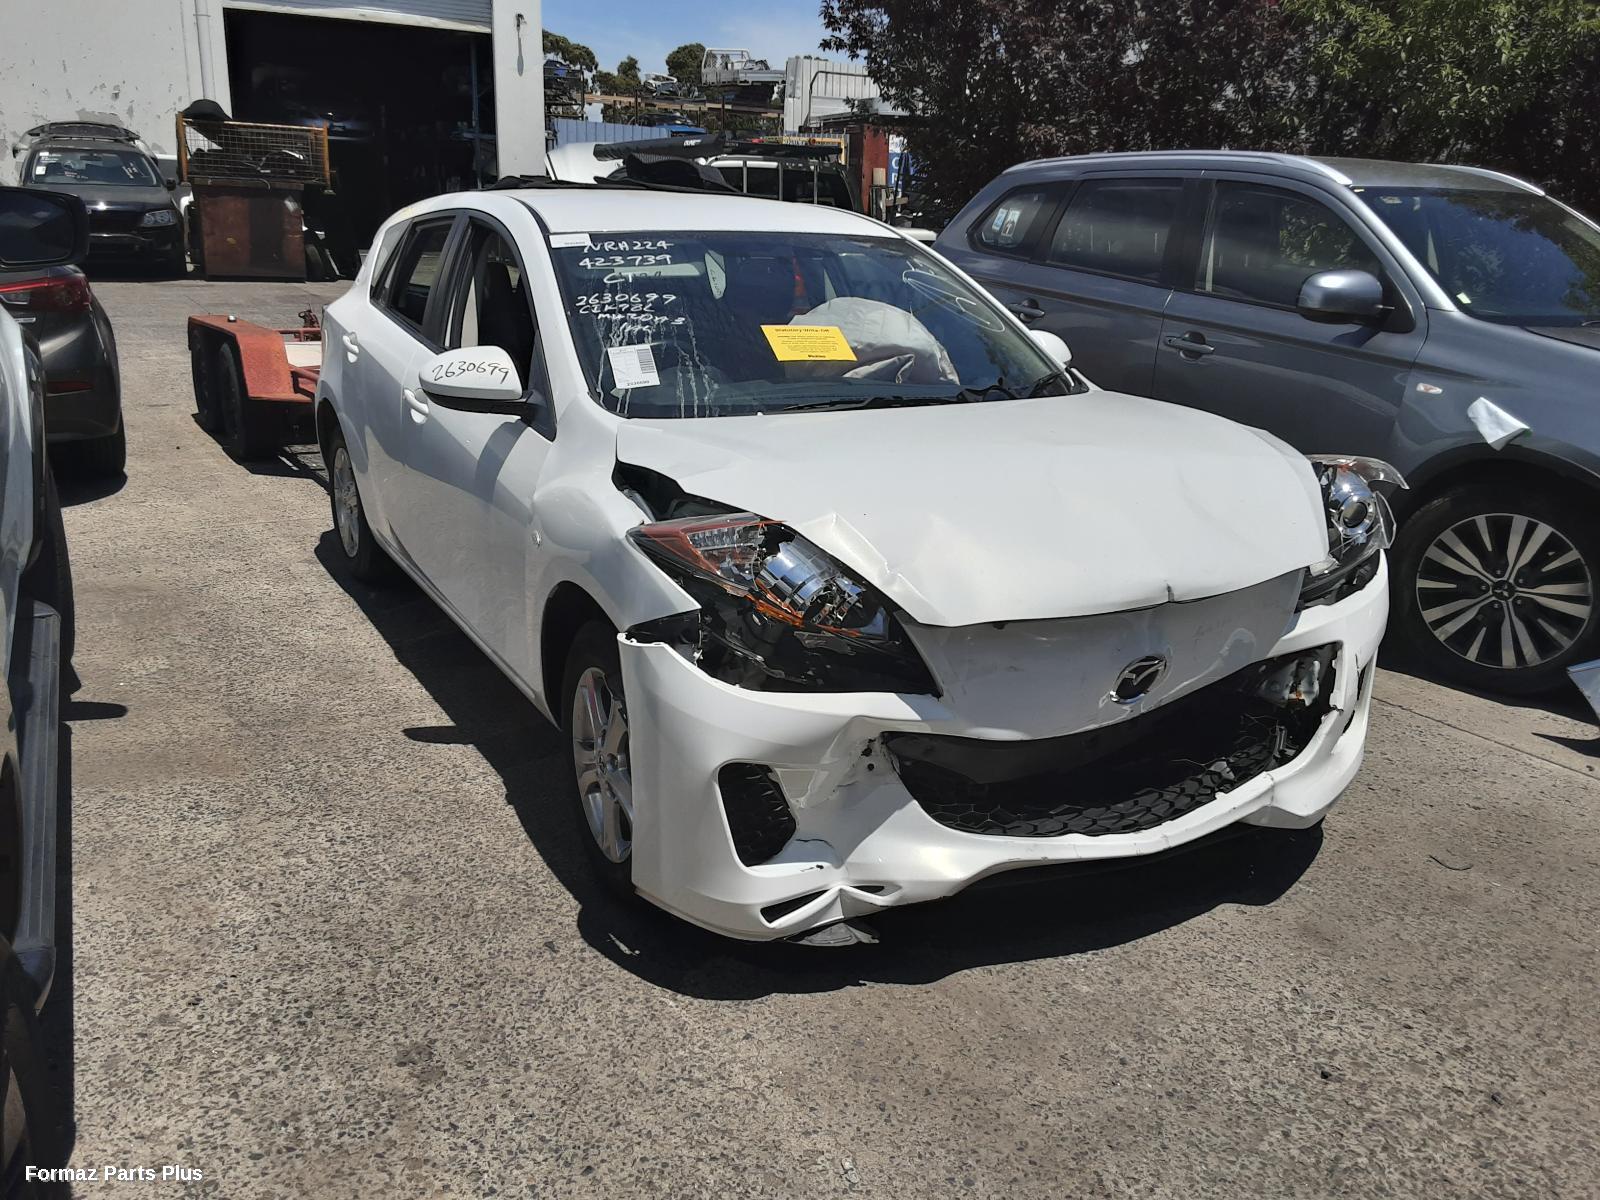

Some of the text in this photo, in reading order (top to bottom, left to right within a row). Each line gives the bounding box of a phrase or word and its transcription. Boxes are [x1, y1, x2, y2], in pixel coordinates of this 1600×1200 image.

[579, 254, 672, 269] 423739
[575, 293, 676, 306] 2630699
[432, 361, 509, 384] 2630699
